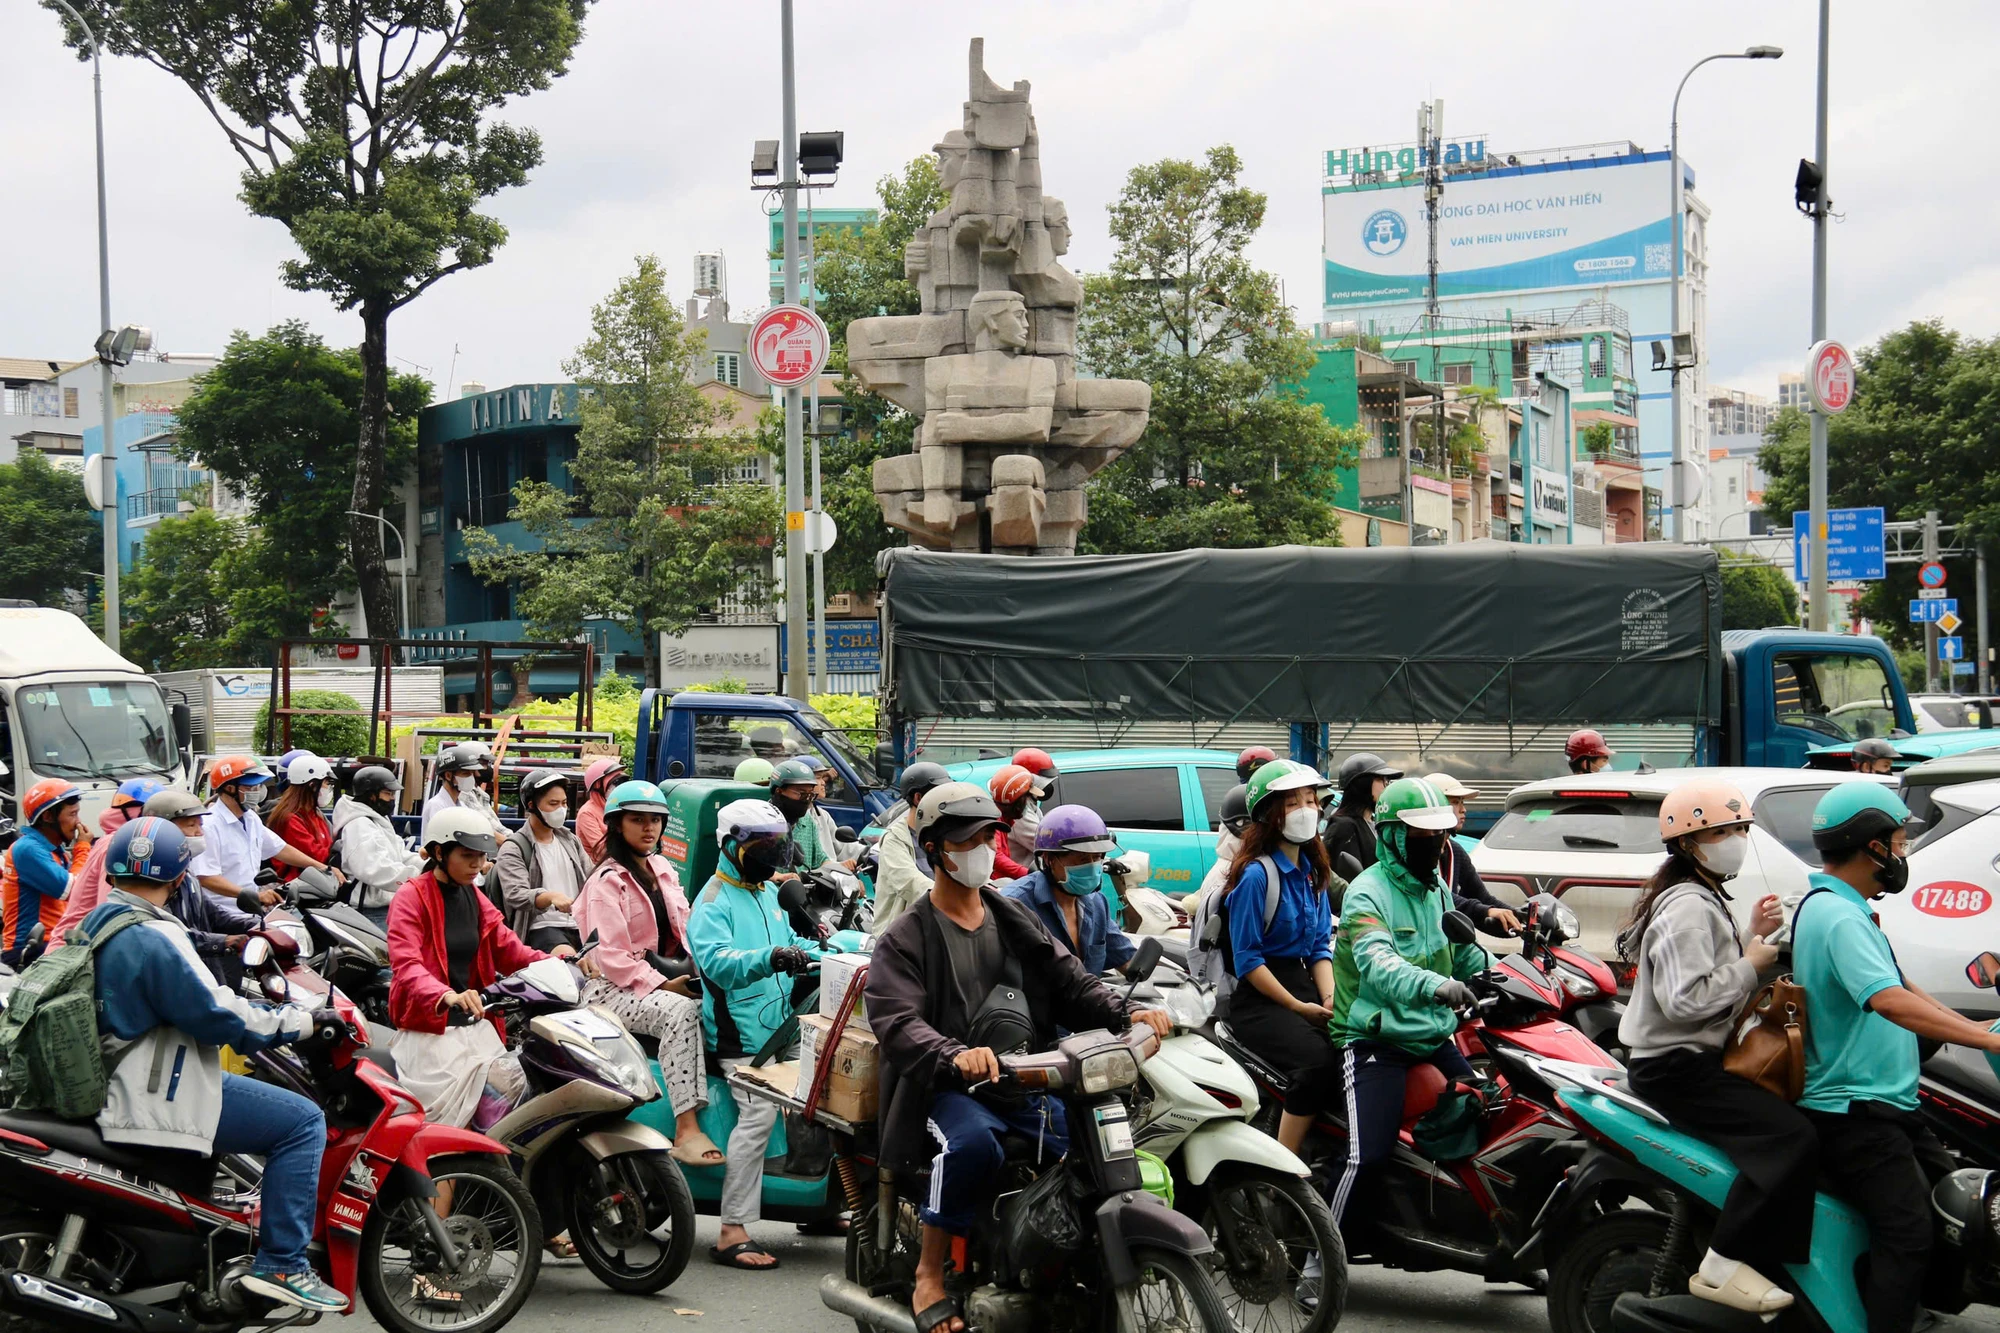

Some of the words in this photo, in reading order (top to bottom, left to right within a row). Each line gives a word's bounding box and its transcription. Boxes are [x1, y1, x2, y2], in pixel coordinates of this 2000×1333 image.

[1450, 236, 1474, 247] VAN
[1477, 233, 1501, 244] HIEN
[1505, 227, 1569, 242] UNIVERSITY
[687, 647, 772, 667] newseal
[1154, 867, 1191, 882] 2088
[1919, 887, 1984, 911] 17488
[1104, 1110, 1125, 1118] HONDA
[1170, 1111, 1199, 1123] HONDA
[79, 1157, 171, 1198] SIRIUS
[333, 1202, 364, 1222] YAMAHA
